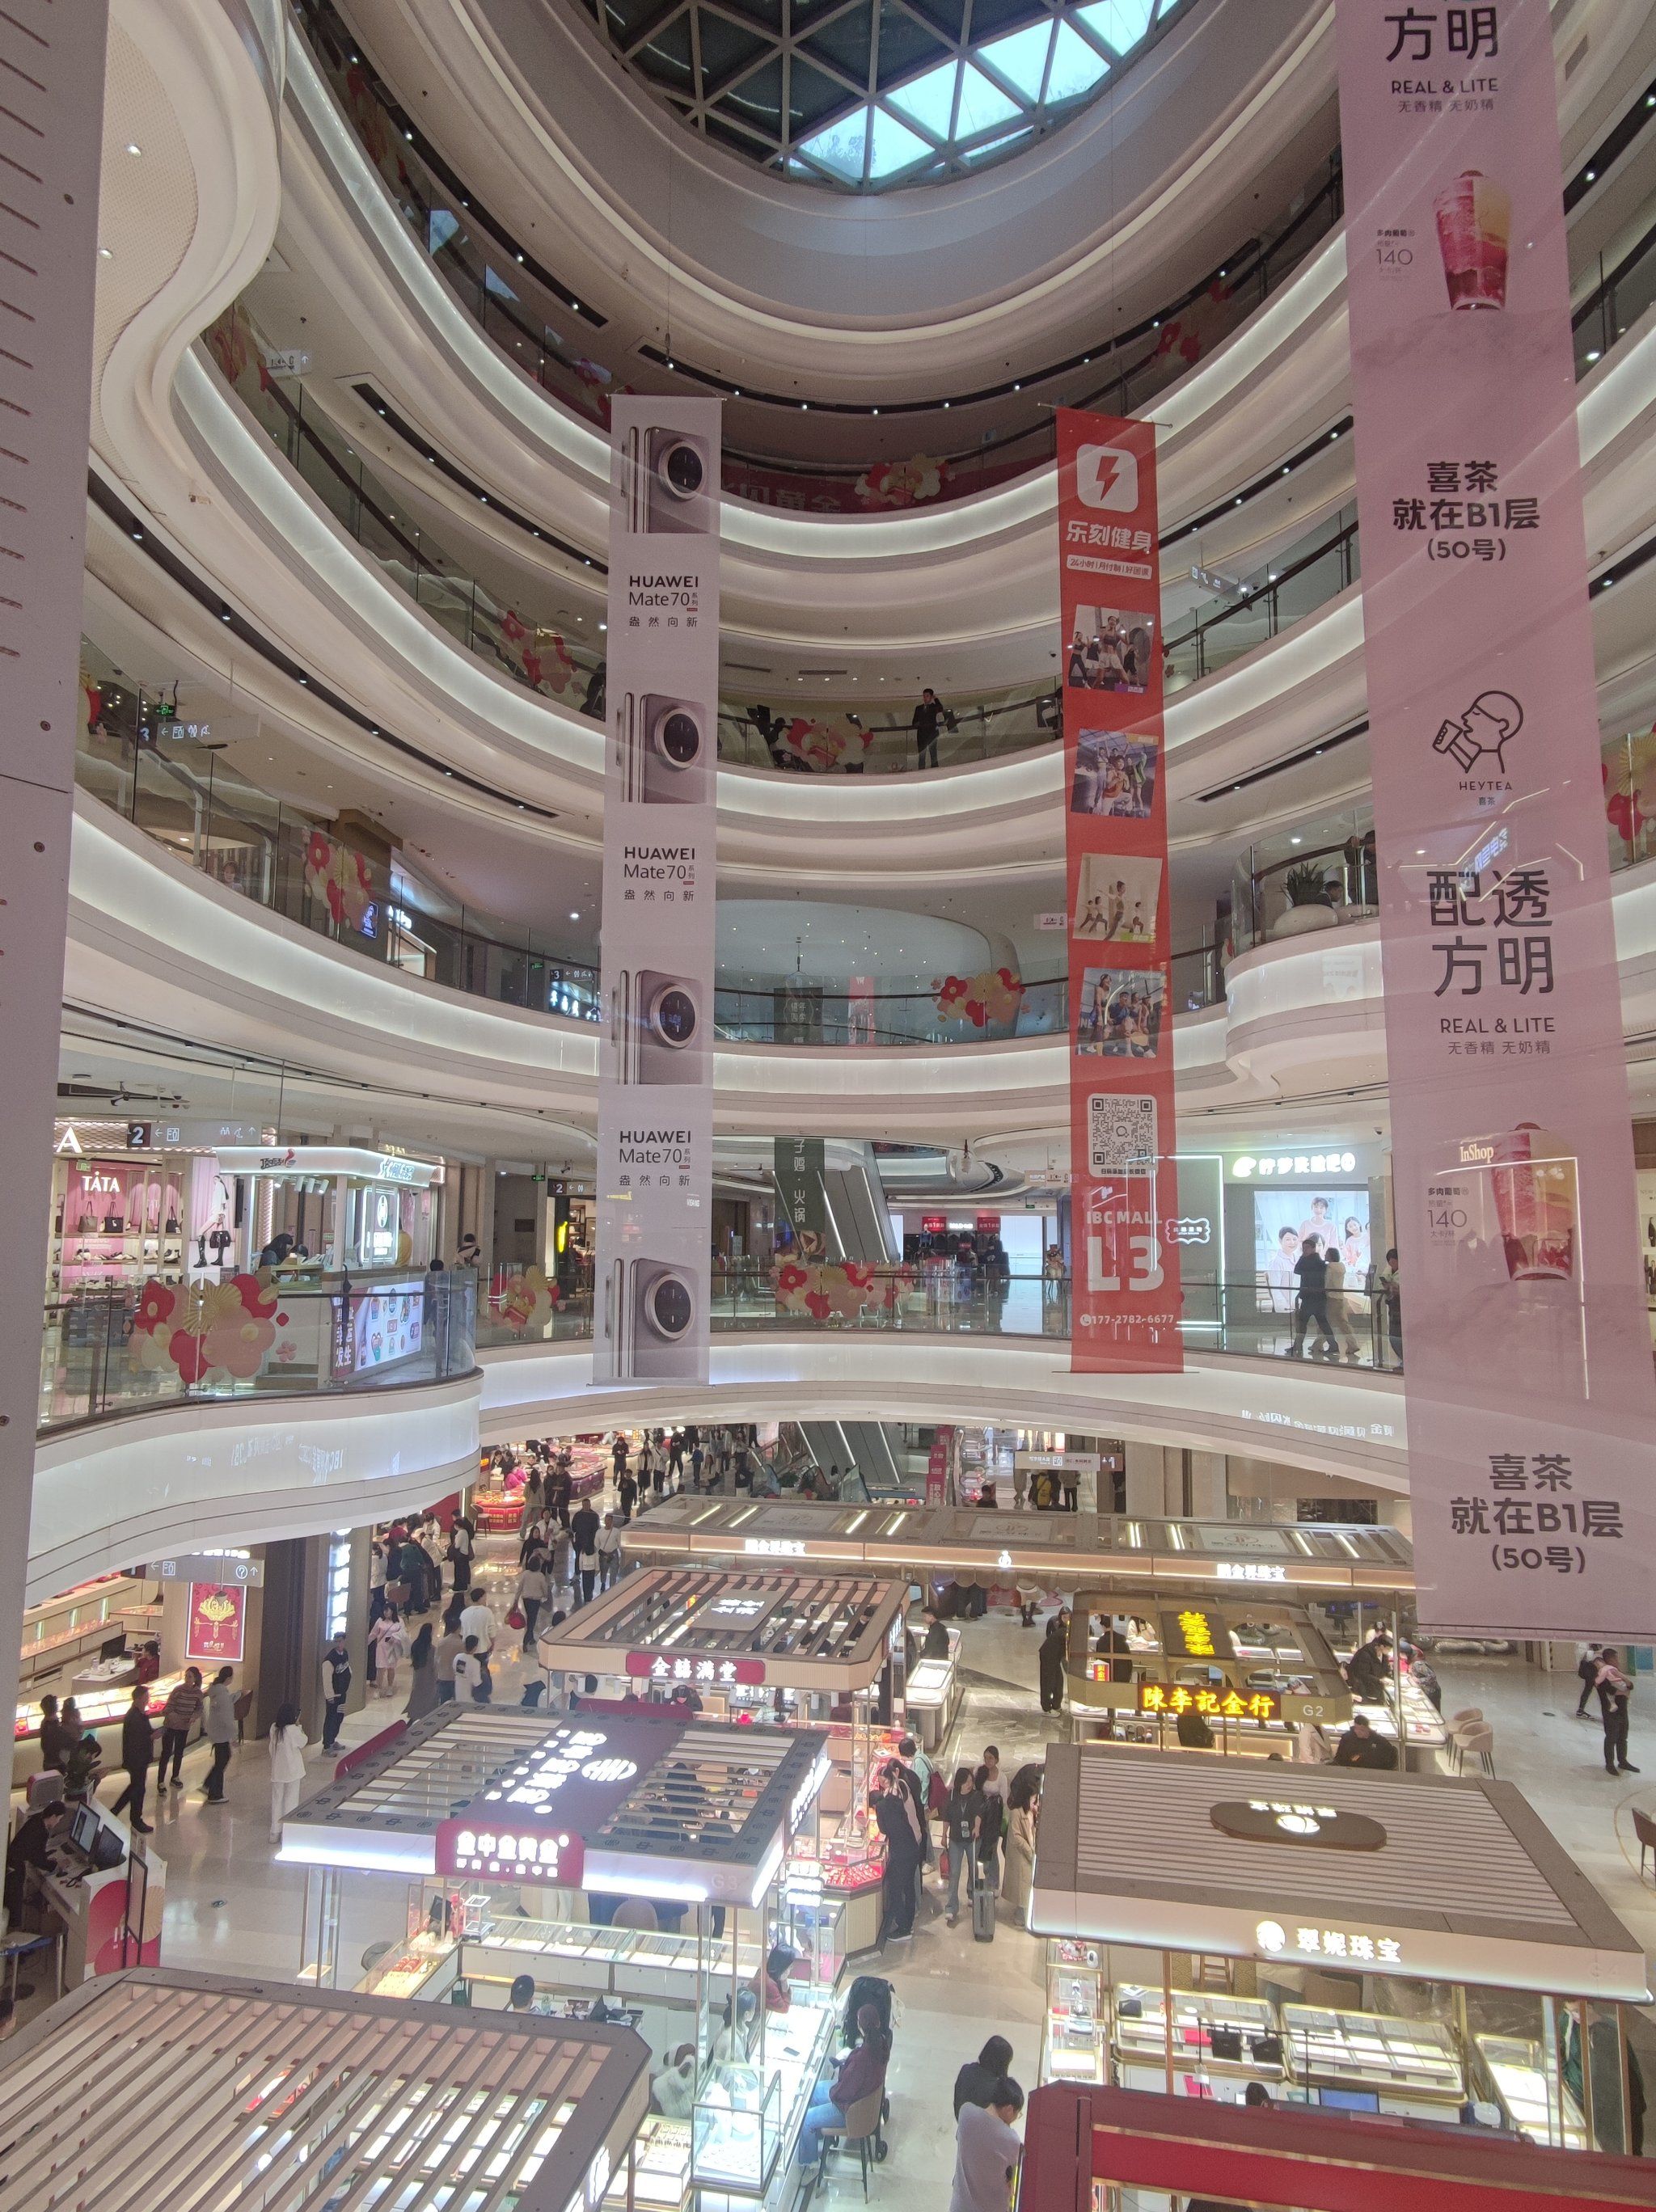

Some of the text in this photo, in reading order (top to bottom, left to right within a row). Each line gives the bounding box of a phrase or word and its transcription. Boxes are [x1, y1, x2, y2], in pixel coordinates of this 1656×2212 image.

[1384, 6, 1498, 62] 方明
[1392, 78, 1498, 94] REAL & LITE
[1376, 249, 1413, 265] 140
[1427, 461, 1498, 492] 喜茶
[1392, 498, 1540, 530] 就在B1层
[1066, 521, 1151, 553] 乐刻健身
[1428, 538, 1506, 560] (50号)
[629, 576, 698, 588] HUAWEI
[1459, 781, 1513, 791] HEYTEA
[624, 846, 695, 860] HUAWEI
[1426, 870, 1552, 928] 配透
[1432, 935, 1553, 998] 方明
[1440, 1017, 1555, 1033] REAL & LITE
[1447, 1040, 1551, 1055] 无香精 无奶精
[619, 1130, 691, 1143] HUAWEI
[1427, 1209, 1468, 1227] 140
[1087, 1236, 1164, 1292] L3
[1489, 1454, 1573, 1492] 喜茶
[1450, 1496, 1624, 1539] 就在B1层
[1492, 1544, 1585, 1573] (50号)
[1142, 1686, 1276, 1719] 陳李記金行
[1303, 1704, 1324, 1717] G2
